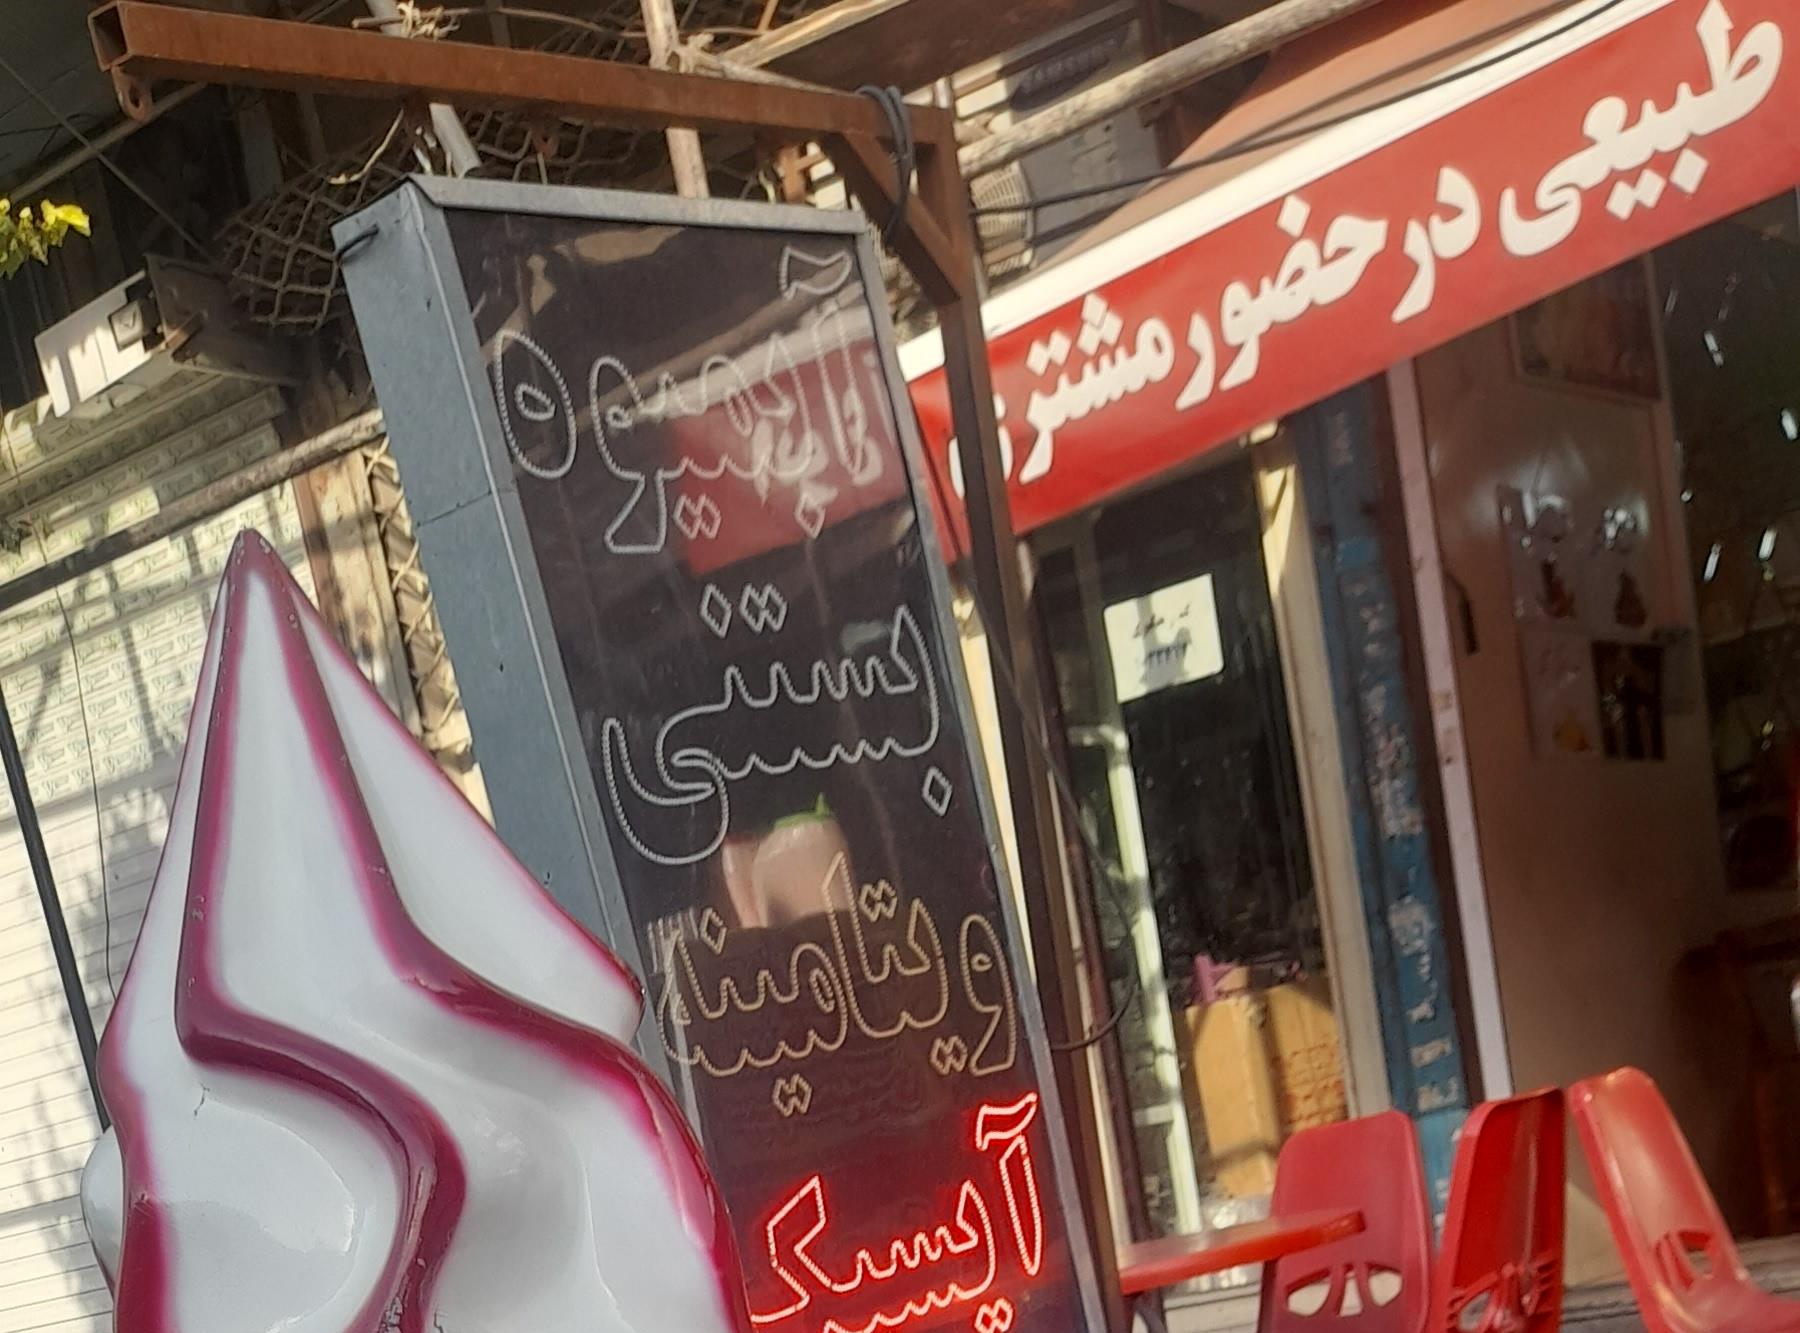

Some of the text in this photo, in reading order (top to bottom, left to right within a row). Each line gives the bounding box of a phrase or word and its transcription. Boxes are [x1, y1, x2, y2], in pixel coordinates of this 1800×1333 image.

[1391, 166, 1482, 325] در
[1498, 0, 1783, 257] طبیعی
[494, 245, 866, 554] آبمیوه
[1174, 193, 1389, 412] حضور
[602, 582, 952, 865] بستنی
[656, 851, 1018, 1117] ویتامینه
